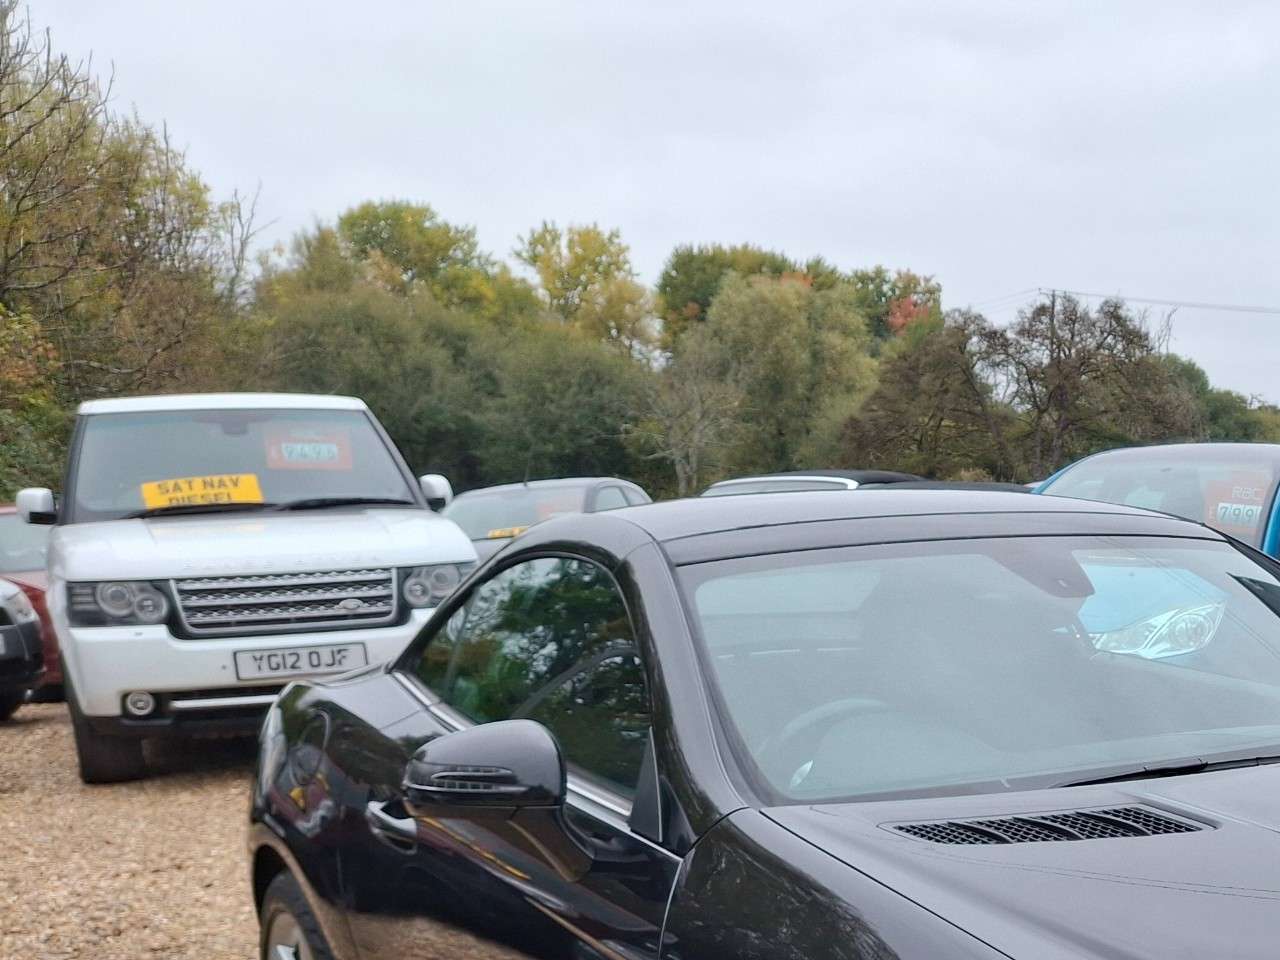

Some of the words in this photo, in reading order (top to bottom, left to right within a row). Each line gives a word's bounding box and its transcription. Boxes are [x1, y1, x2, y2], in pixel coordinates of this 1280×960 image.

[157, 480, 195, 495] SAT
[202, 475, 241, 489] NAV
[251, 652, 302, 671] YG12
